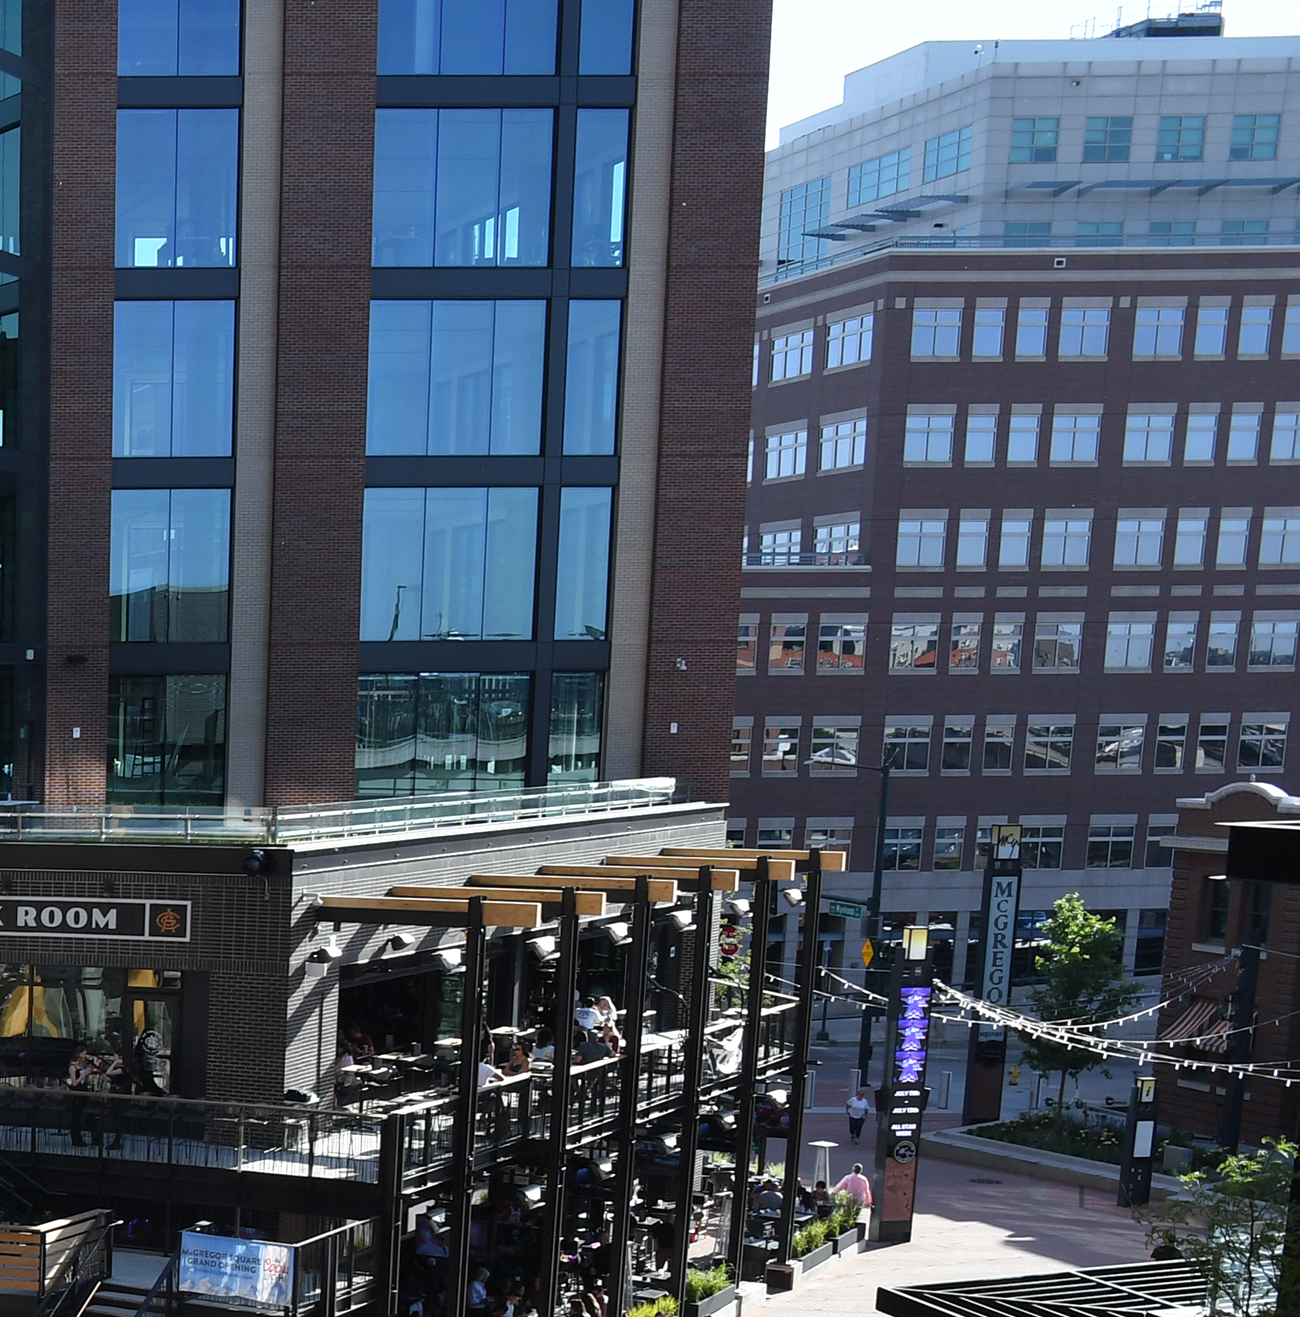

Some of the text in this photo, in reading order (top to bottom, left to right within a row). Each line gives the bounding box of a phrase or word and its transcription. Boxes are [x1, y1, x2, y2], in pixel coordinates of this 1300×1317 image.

[16, 906, 118, 930] ROOM
[187, 1257, 217, 1268] GRAND
[218, 1262, 257, 1274] OPENING
[228, 1254, 262, 1266] SQUARE
